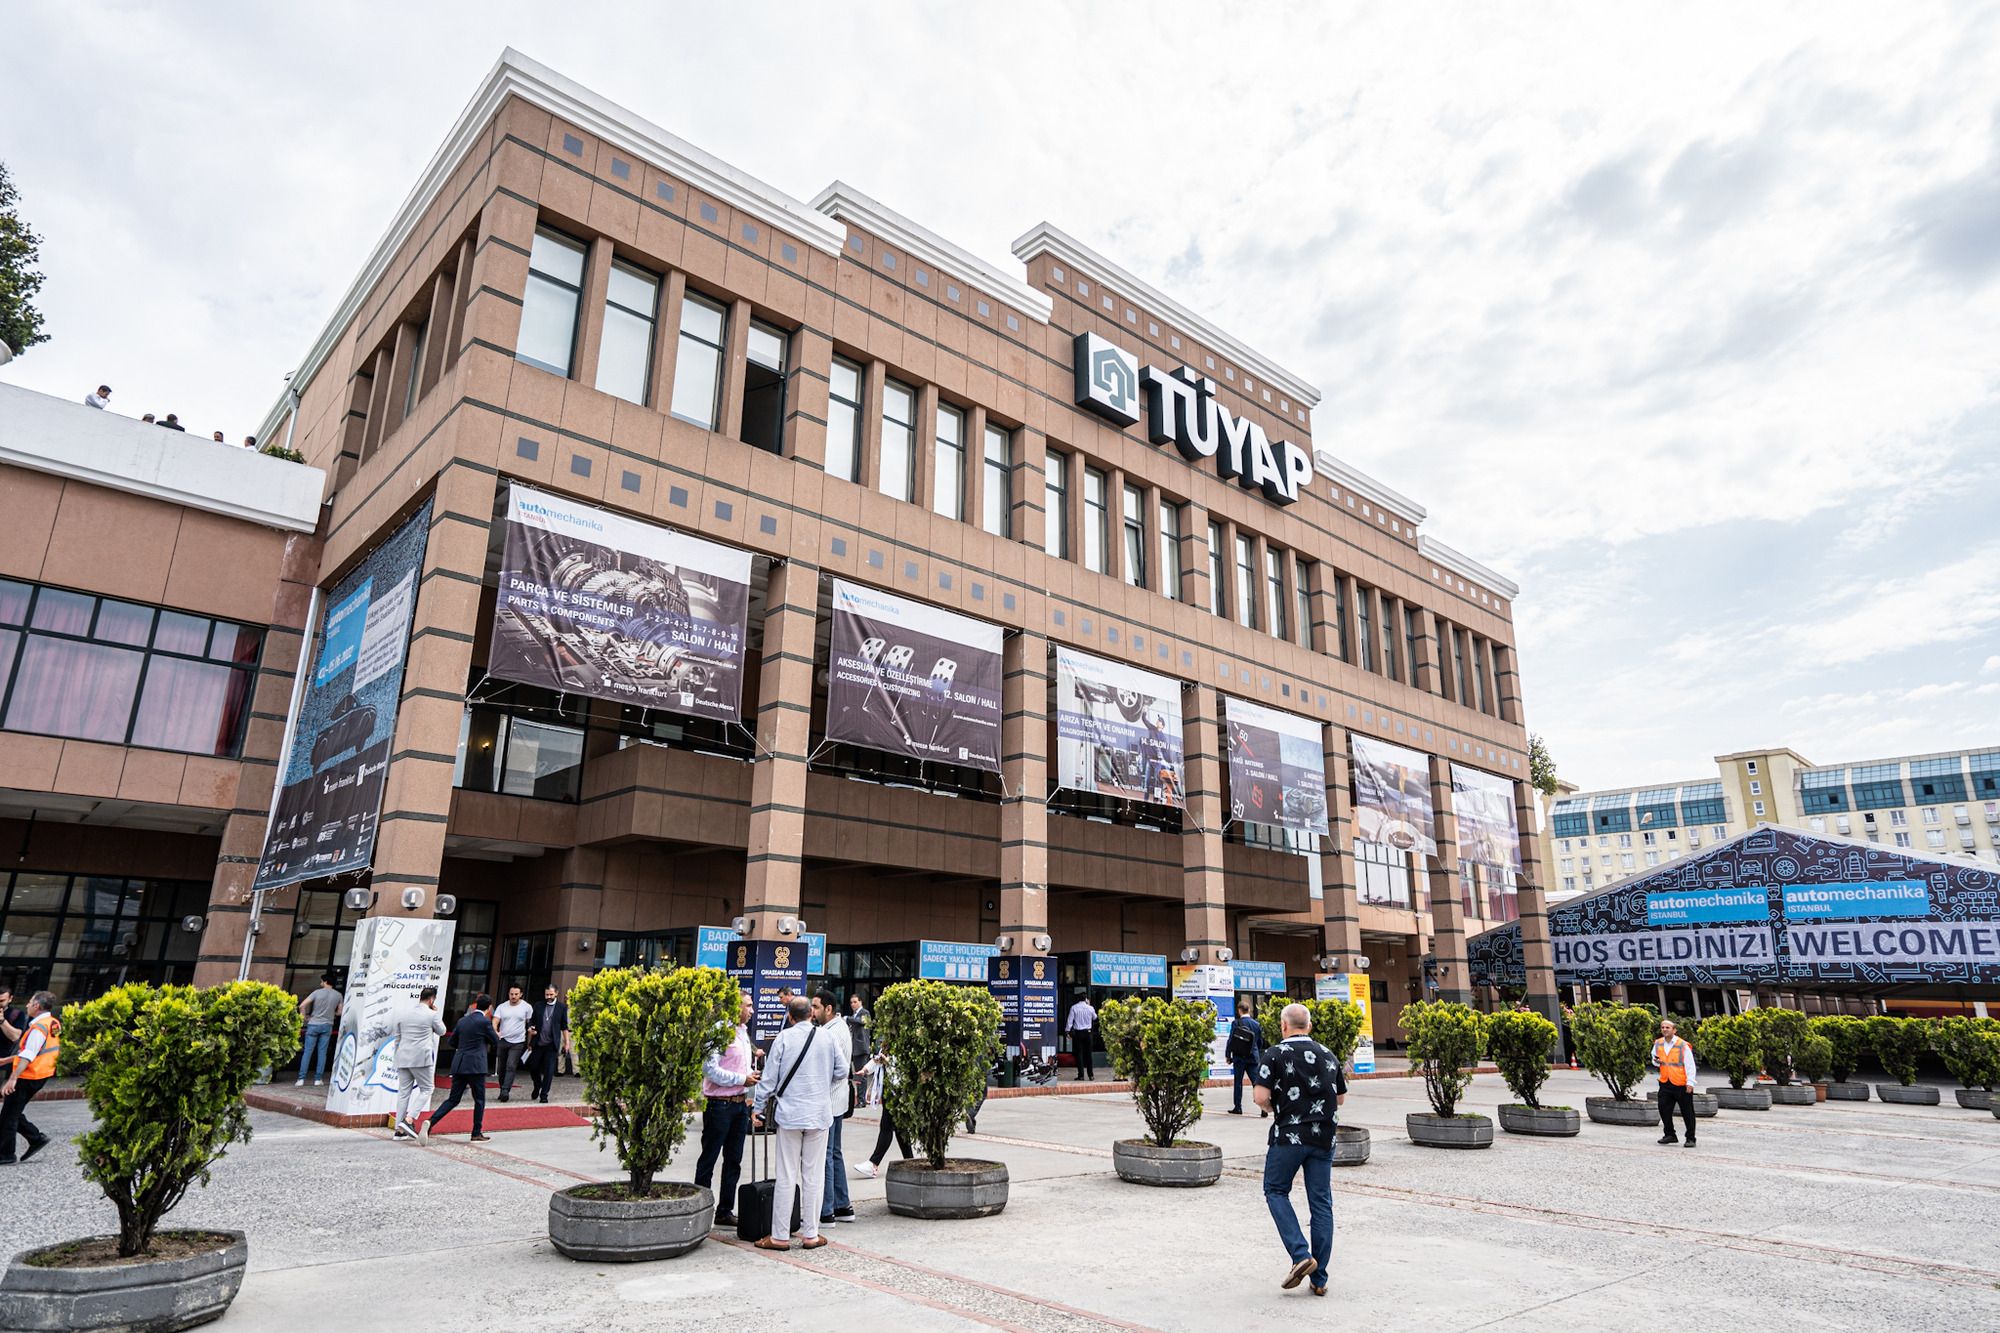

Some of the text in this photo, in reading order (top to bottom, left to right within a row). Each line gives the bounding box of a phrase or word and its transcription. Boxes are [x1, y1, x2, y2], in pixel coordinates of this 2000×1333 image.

[1140, 364, 1313, 505] TÜYAP
[519, 501, 603, 532] automechanika
[510, 578, 634, 617] PARÇA VE SİSTEMLER
[508, 595, 539, 610] PARTS
[551, 606, 615, 627] COMPONENTS
[672, 630, 739, 654] SALON / HALL
[837, 657, 875, 674] AKSESUAR
[837, 671, 877, 687] ACCESSORIES
[883, 682, 921, 698] CUSTOMIZING
[943, 690, 952, 699] 12.
[954, 692, 976, 705] SALON
[981, 699, 998, 710] HALL
[1239, 729, 1249, 742] 60
[1233, 799, 1245, 819] 20
[1650, 891, 1765, 910] automechanika
[1786, 884, 1925, 903] automechanika
[1650, 911, 1688, 920] ISTANBUL
[1787, 903, 1833, 913] ISTANBUL
[928, 944, 954, 954] BADGE
[955, 946, 991, 957] HOLDERS
[1554, 928, 1768, 968] HOŞ GELDİNİZ!
[923, 955, 948, 963] SADECE
[949, 956, 965, 964] YAKA
[1096, 953, 1117, 963] BADGE
[1118, 955, 1146, 965] HOLDERS
